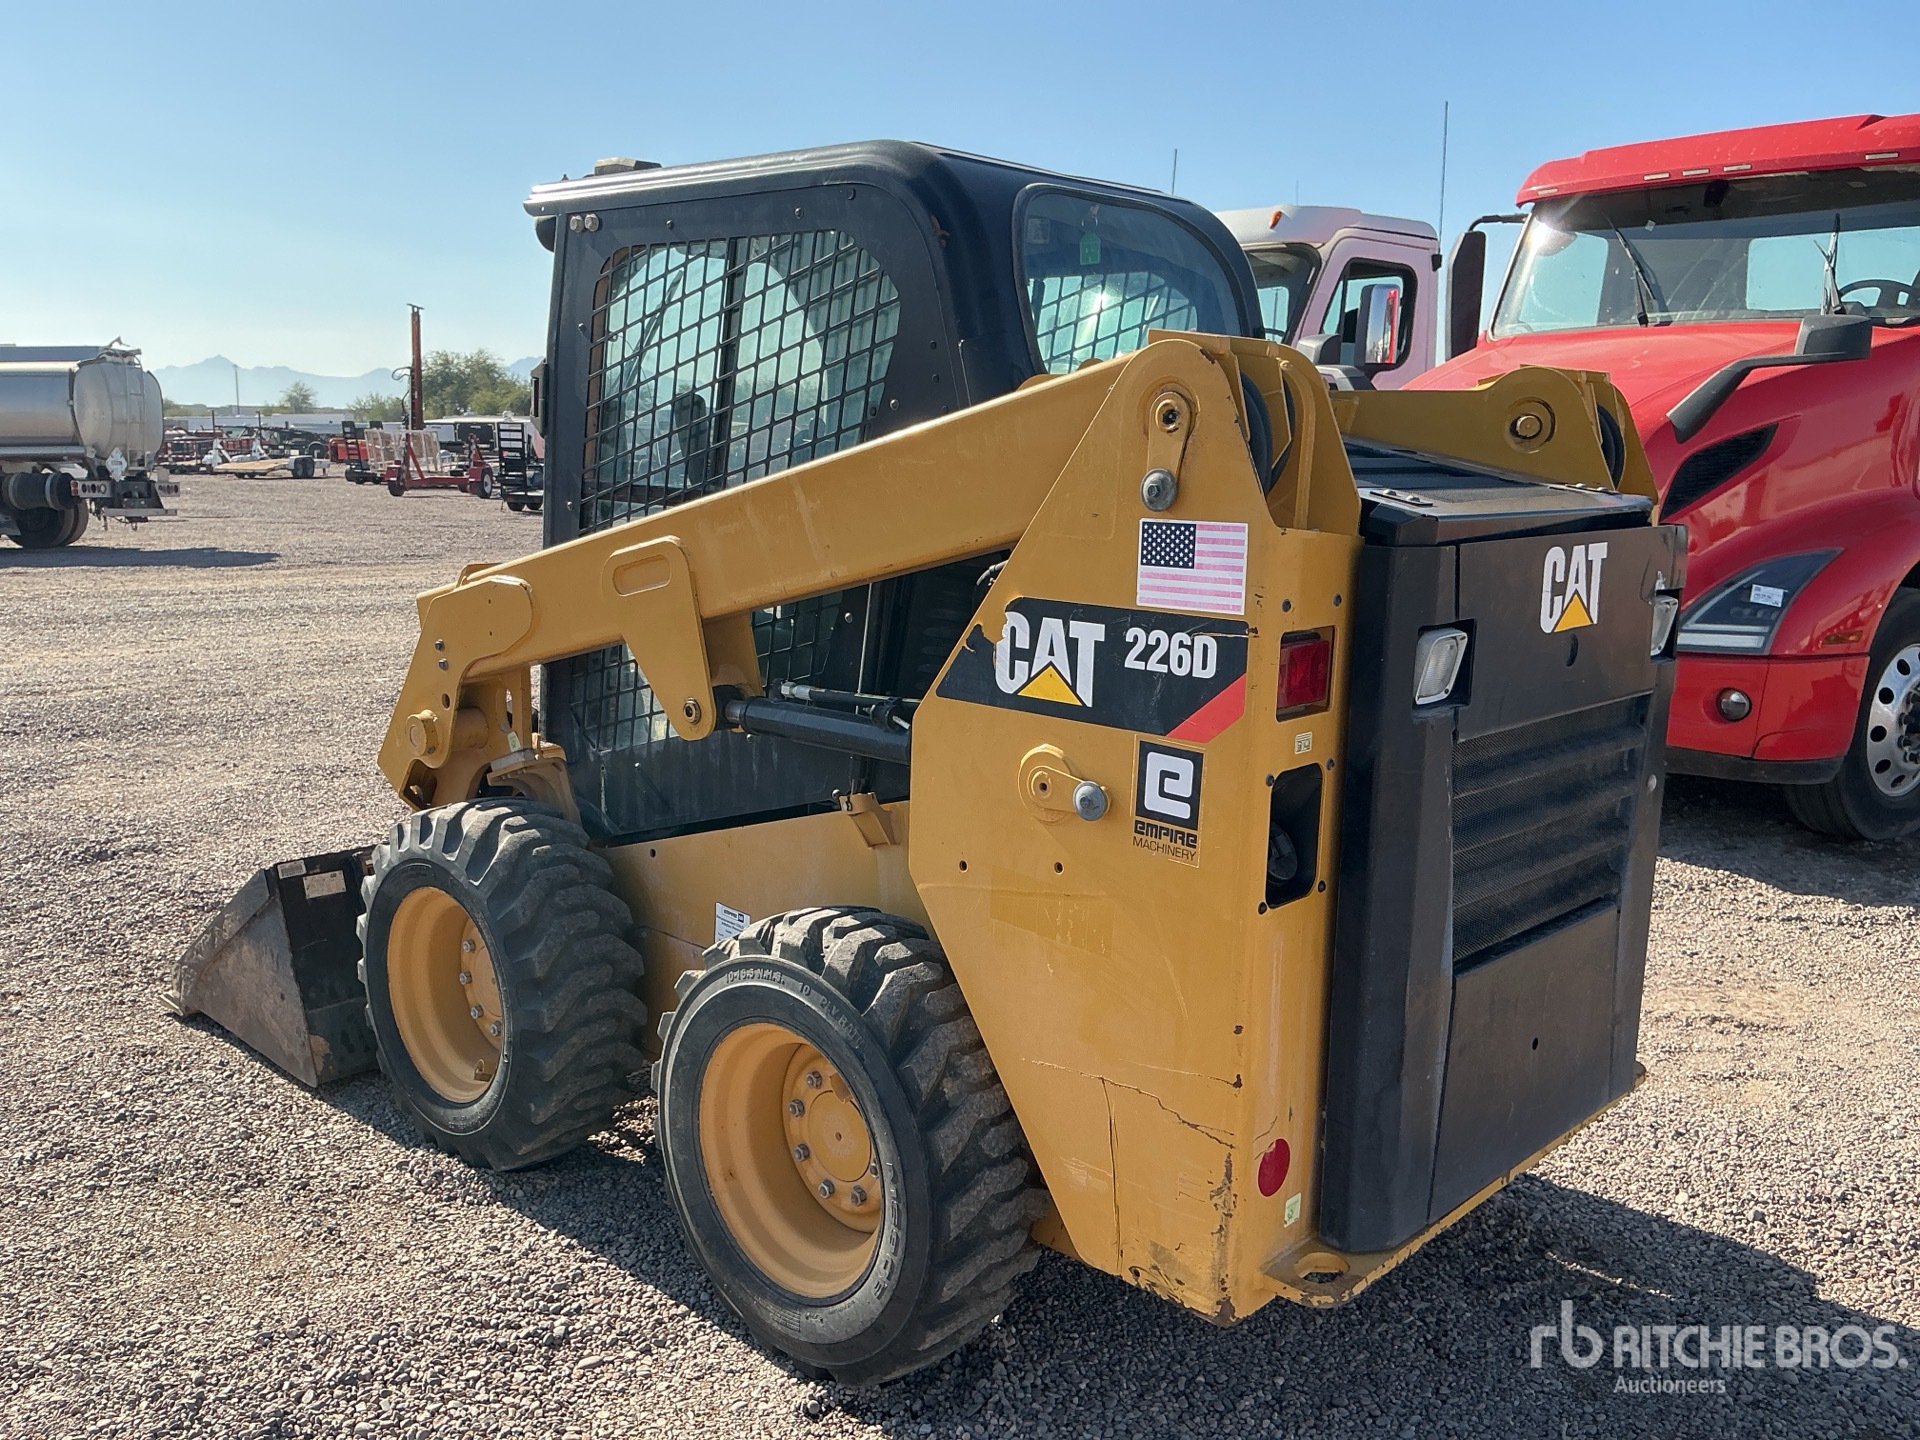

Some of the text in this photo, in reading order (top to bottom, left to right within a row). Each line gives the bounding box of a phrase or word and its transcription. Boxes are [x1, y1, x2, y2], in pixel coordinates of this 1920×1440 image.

[1540, 541, 1609, 635] CAT
[995, 611, 1218, 708] CAT 226D
[1133, 836, 1197, 862] MACHINERY
[798, 981, 811, 997] 10
[819, 996, 840, 1016] PLY
